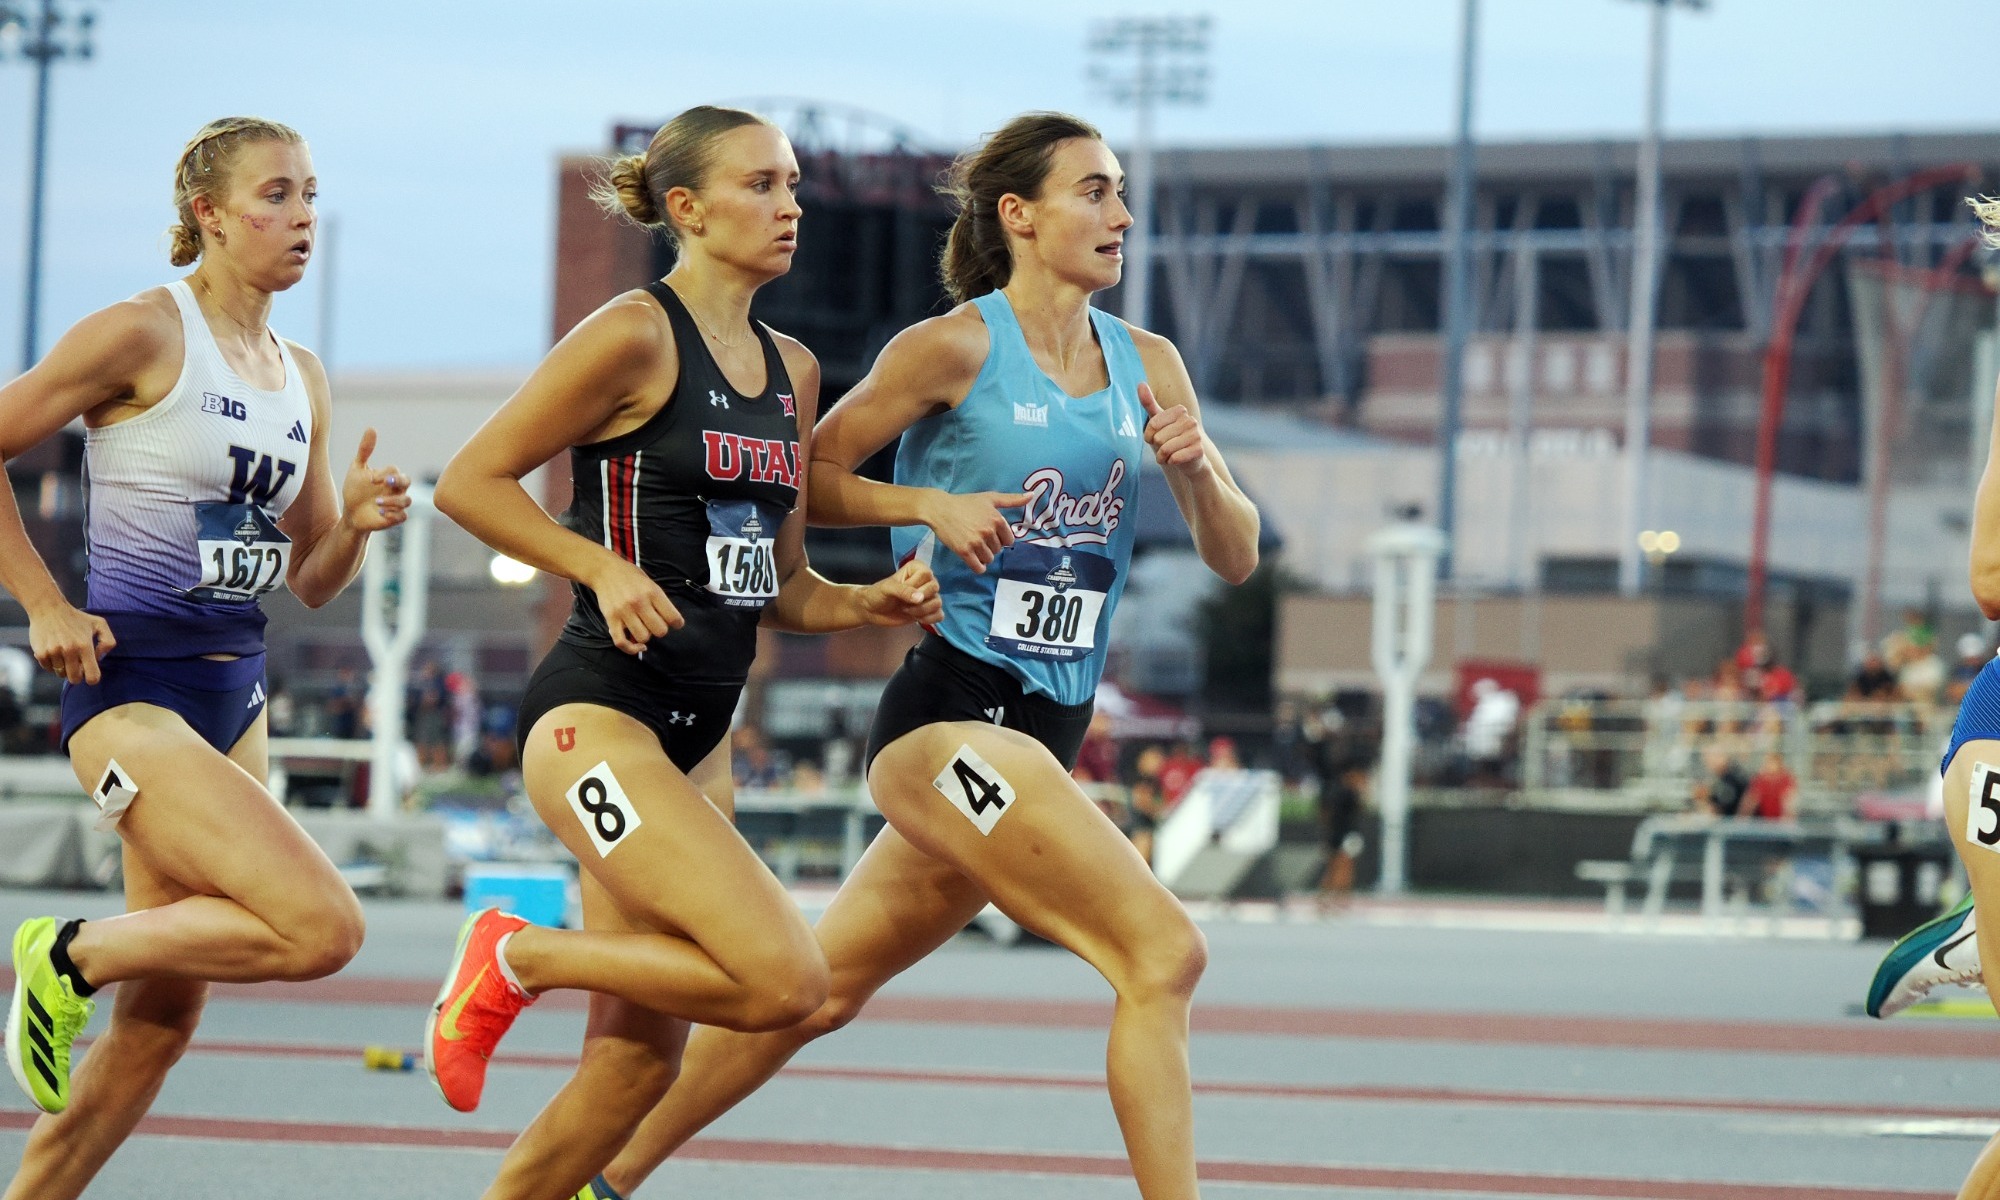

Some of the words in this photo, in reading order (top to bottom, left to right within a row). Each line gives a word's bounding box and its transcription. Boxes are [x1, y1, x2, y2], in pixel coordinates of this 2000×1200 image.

[1013, 401, 1048, 424] VALLEY
[228, 443, 296, 508] W
[1010, 458, 1125, 545] Drake
[207, 547, 282, 590] 1672
[717, 544, 773, 594] 1580
[1016, 590, 1083, 643] 380
[1017, 643, 1040, 654] COLLEGE
[1060, 648, 1073, 657] TEXAS
[554, 727, 576, 752] U
[578, 777, 626, 842] 8
[952, 757, 1006, 816] 4
[1977, 770, 2000, 846] 5
